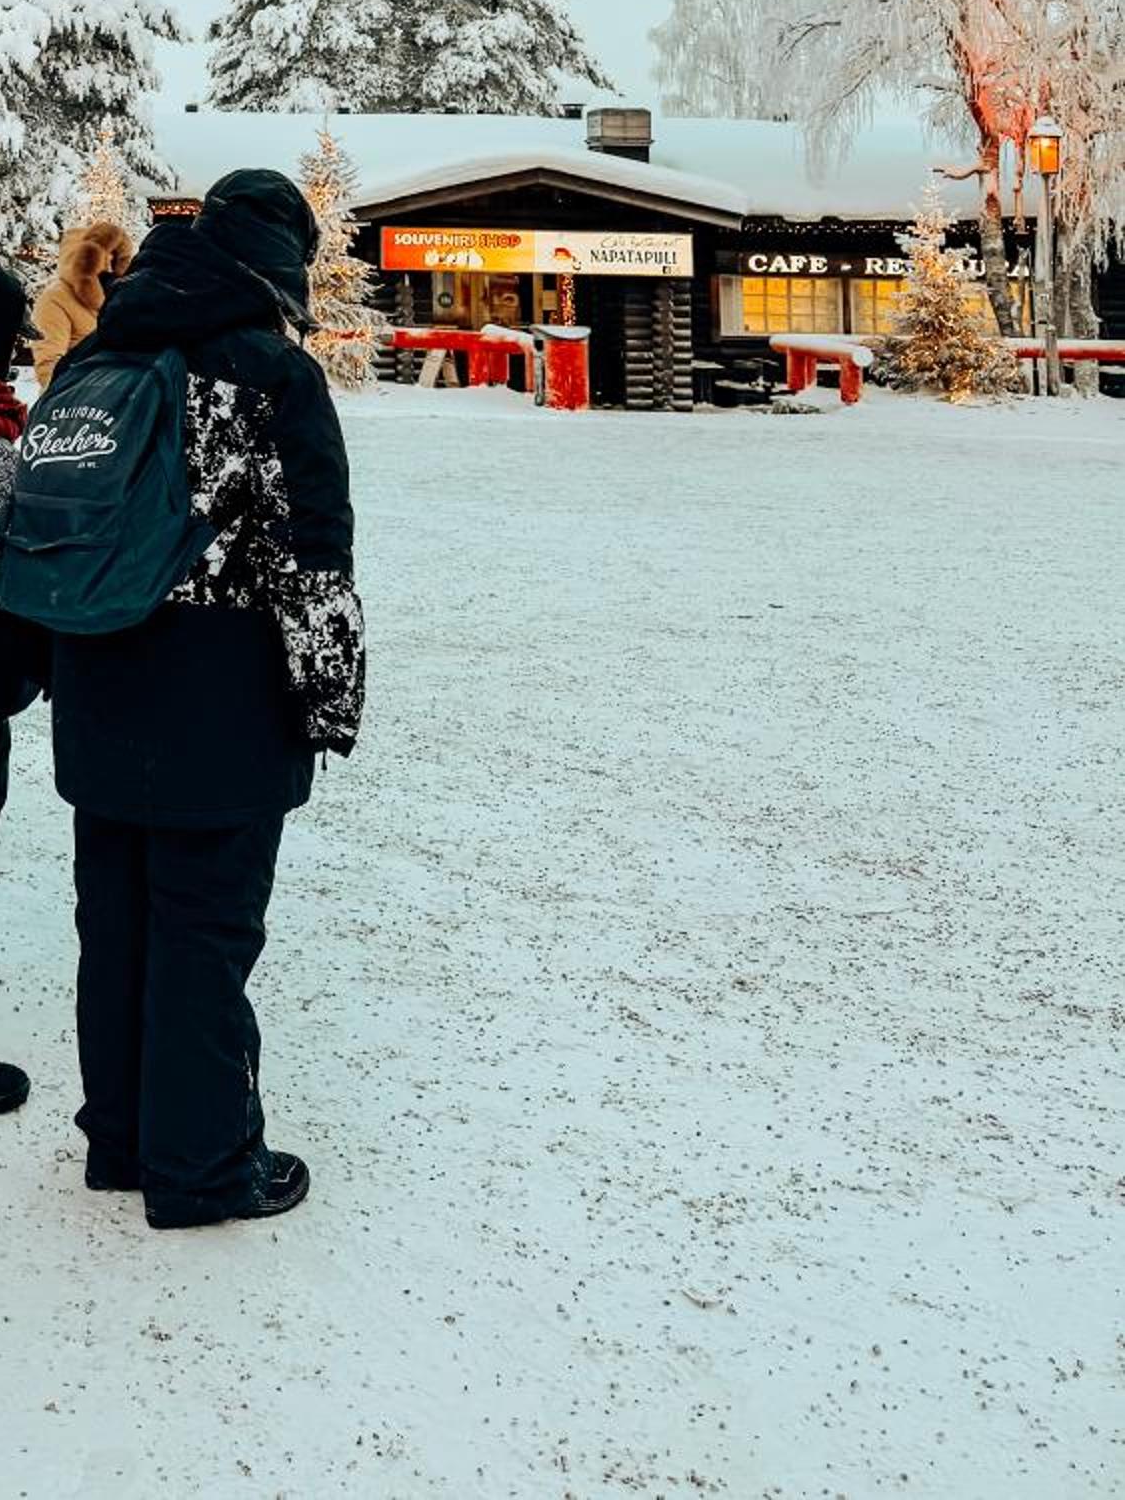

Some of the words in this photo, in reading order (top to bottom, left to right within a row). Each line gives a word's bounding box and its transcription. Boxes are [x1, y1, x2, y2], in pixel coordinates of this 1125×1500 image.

[478, 233, 522, 249] SHOP
[748, 254, 828, 274] CAFE
[50, 404, 116, 427] CALIFORNIA
[23, 423, 117, 470] Skechers
